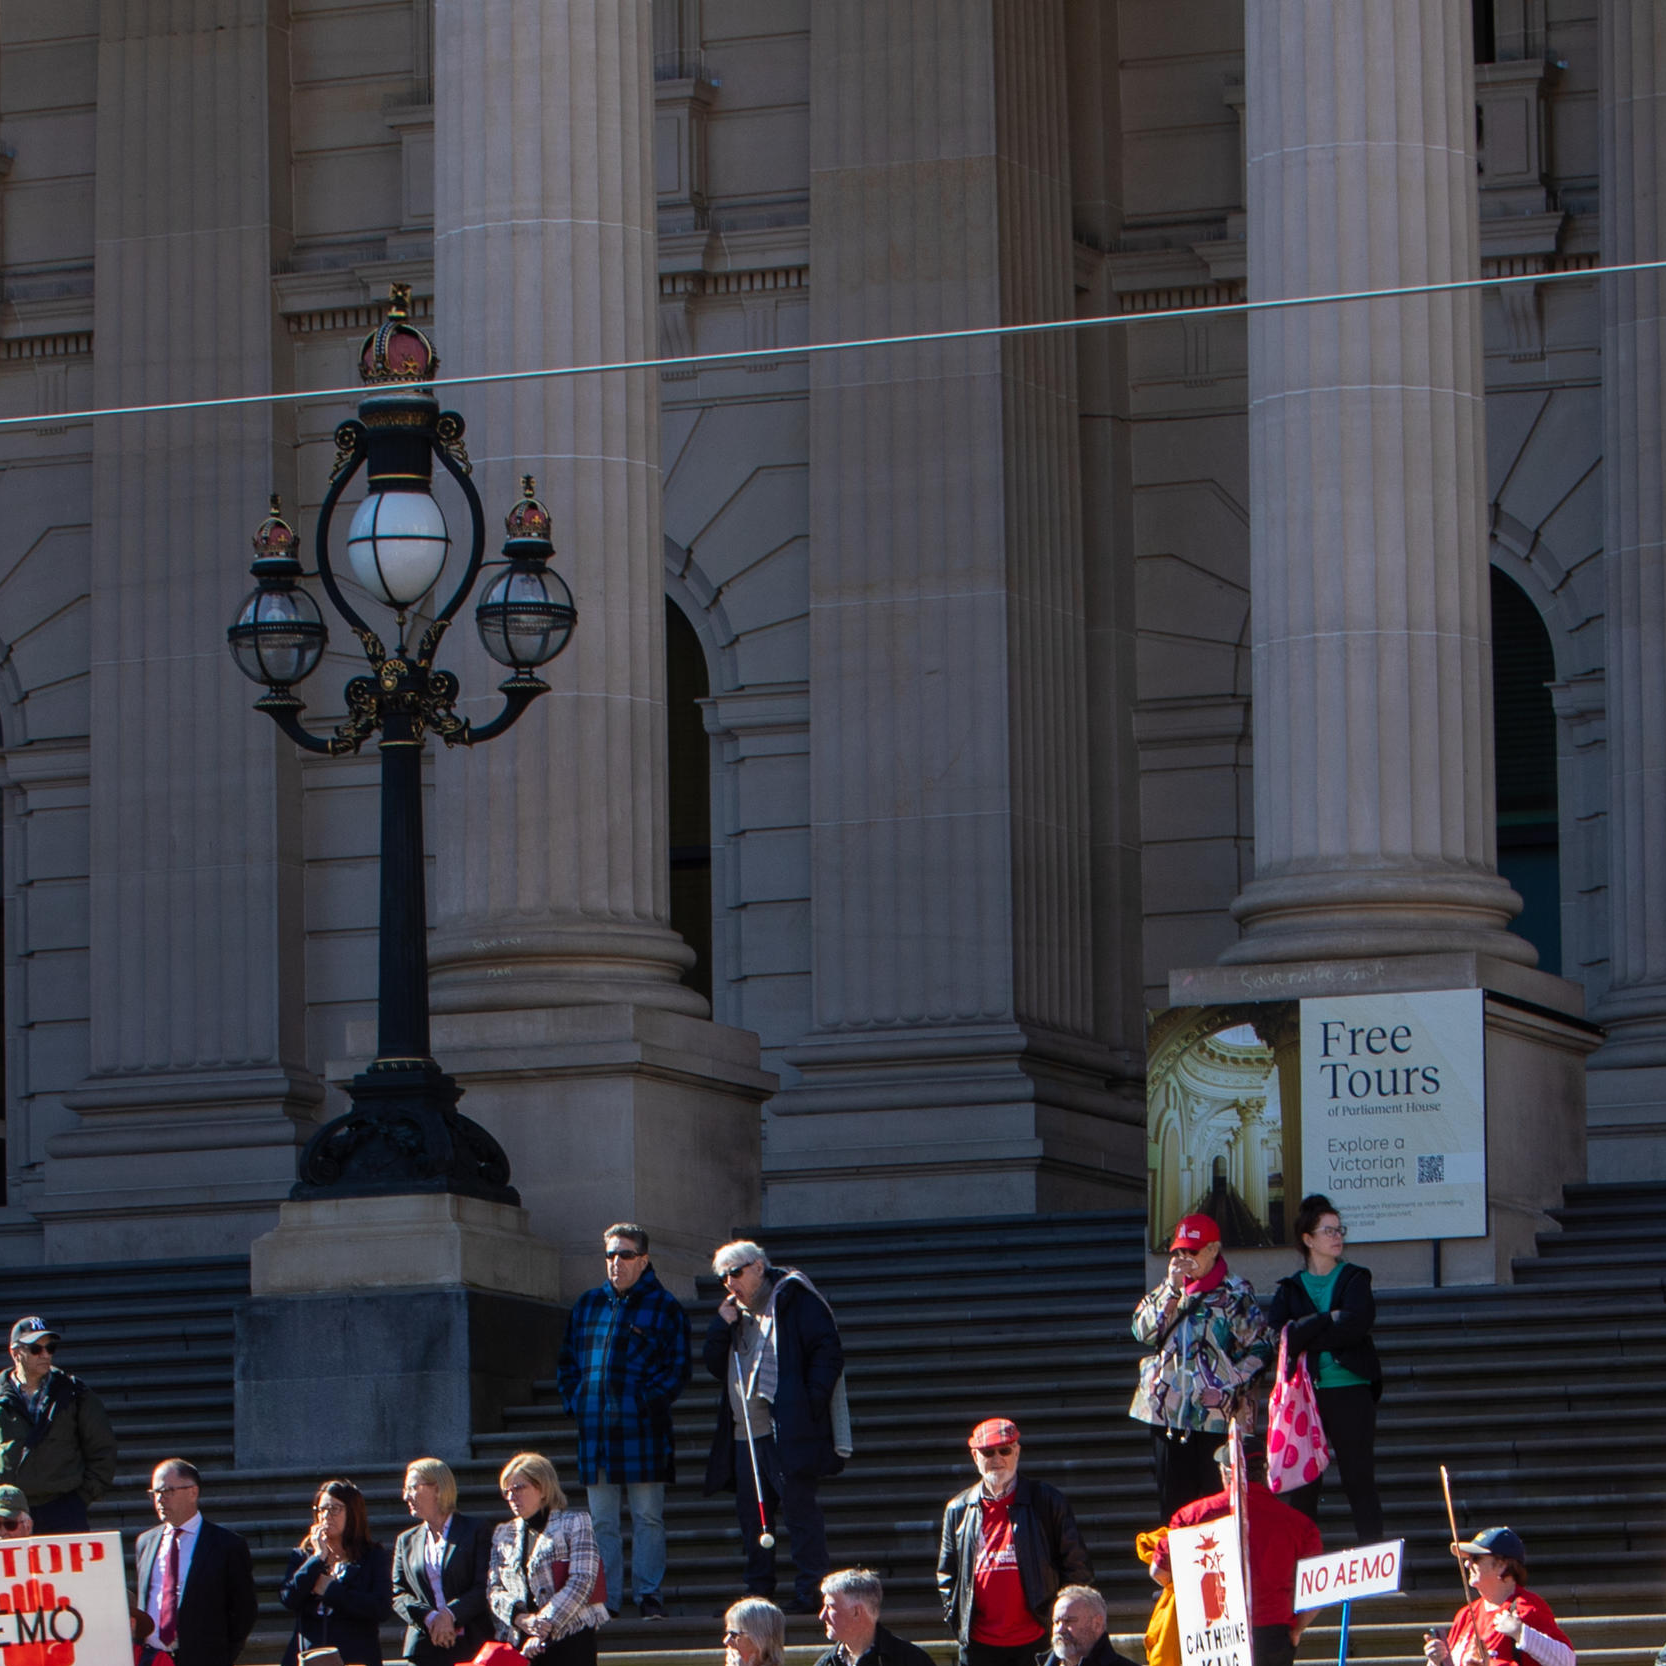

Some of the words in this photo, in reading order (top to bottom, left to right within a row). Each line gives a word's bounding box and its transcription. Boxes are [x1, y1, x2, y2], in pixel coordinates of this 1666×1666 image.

[1319, 1021, 1412, 1057] Free
[1319, 1063, 1440, 1099] Tours
[1328, 1105, 1339, 1117] of
[1342, 1103, 1402, 1117] Parliament
[1406, 1102, 1441, 1114] House
[1328, 1137, 1389, 1155] Explore
[1394, 1138, 1406, 1151] a
[1329, 1155, 1405, 1172] Victorian
[1329, 1172, 1405, 1190] landmark
[1300, 1567, 1329, 1596] NO
[1334, 1552, 1395, 1588] AEMO
